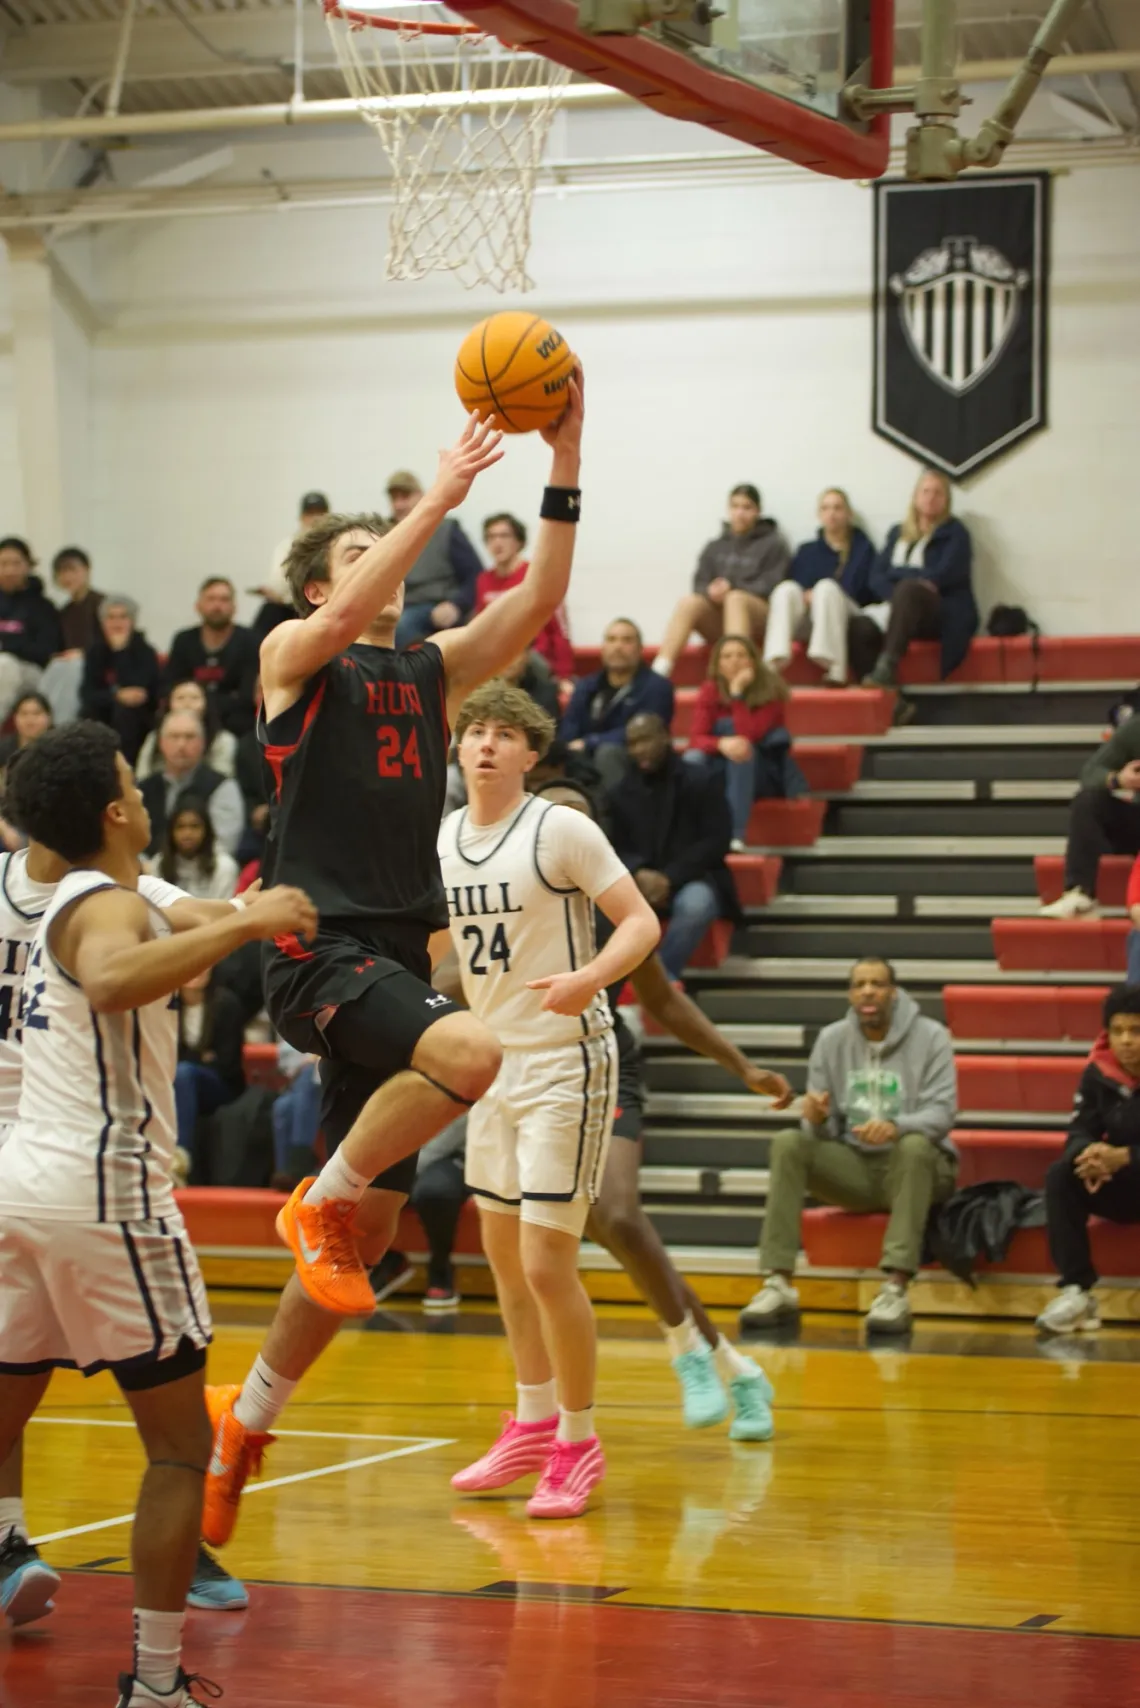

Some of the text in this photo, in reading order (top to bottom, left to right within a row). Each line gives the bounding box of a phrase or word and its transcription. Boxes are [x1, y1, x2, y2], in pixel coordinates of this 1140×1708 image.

[365, 680, 423, 716] HUN
[376, 724, 422, 778] 24
[445, 882, 523, 917] HILL
[461, 922, 511, 975] 24
